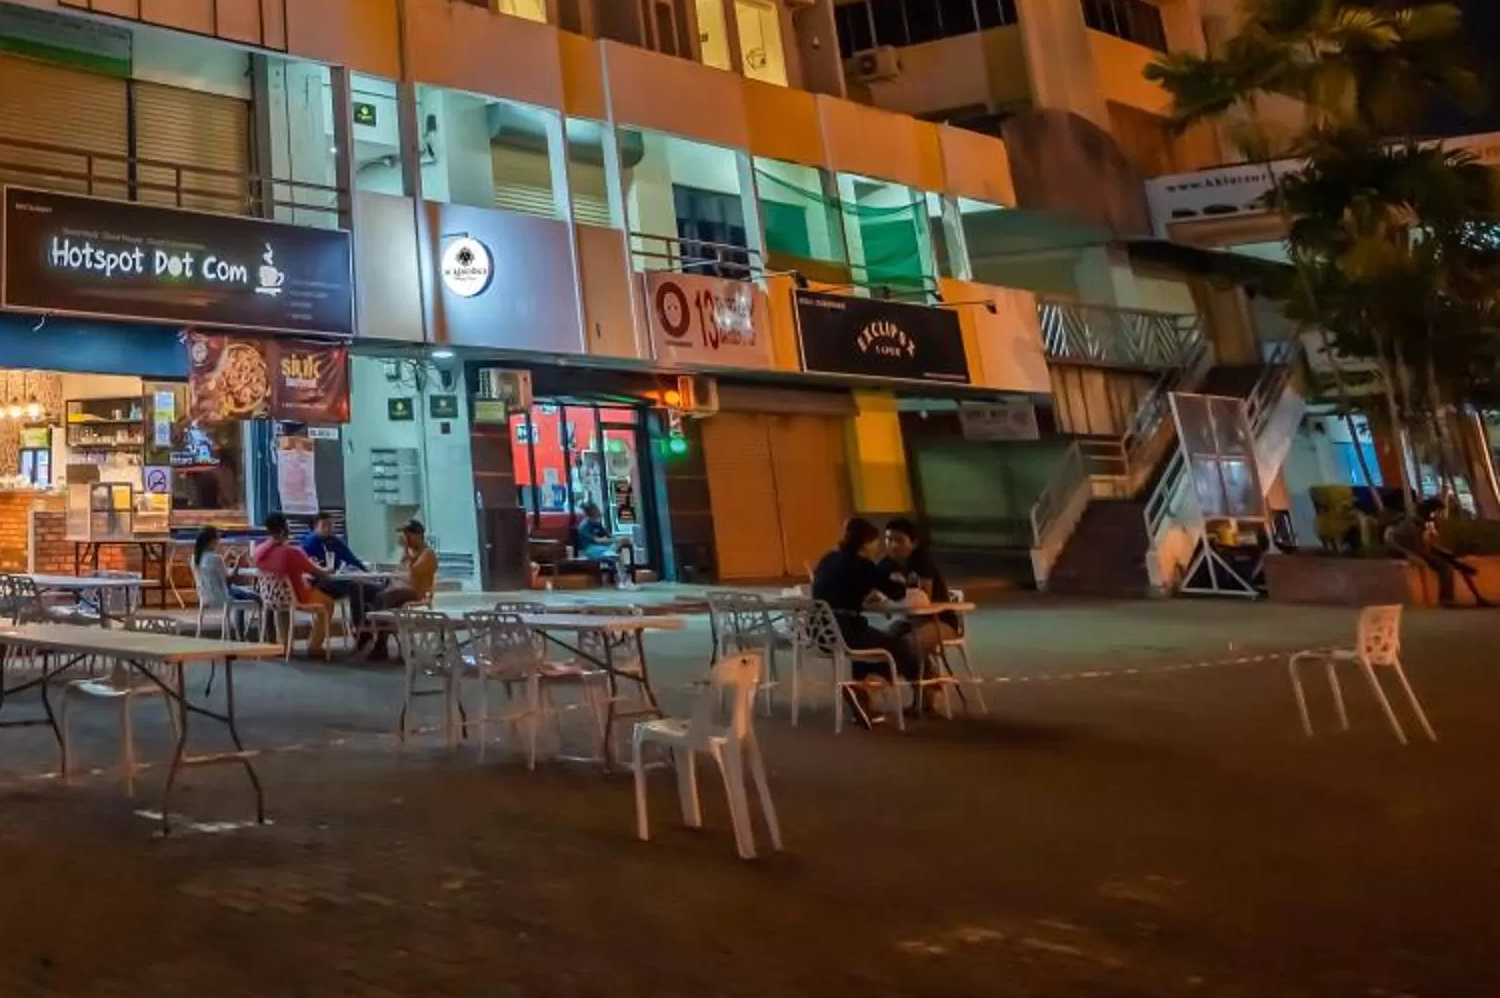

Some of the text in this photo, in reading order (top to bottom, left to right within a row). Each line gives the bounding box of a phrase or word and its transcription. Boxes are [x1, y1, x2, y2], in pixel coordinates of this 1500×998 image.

[51, 237, 144, 276] Hotspot
[155, 250, 193, 277] Dot
[203, 256, 248, 283] Com
